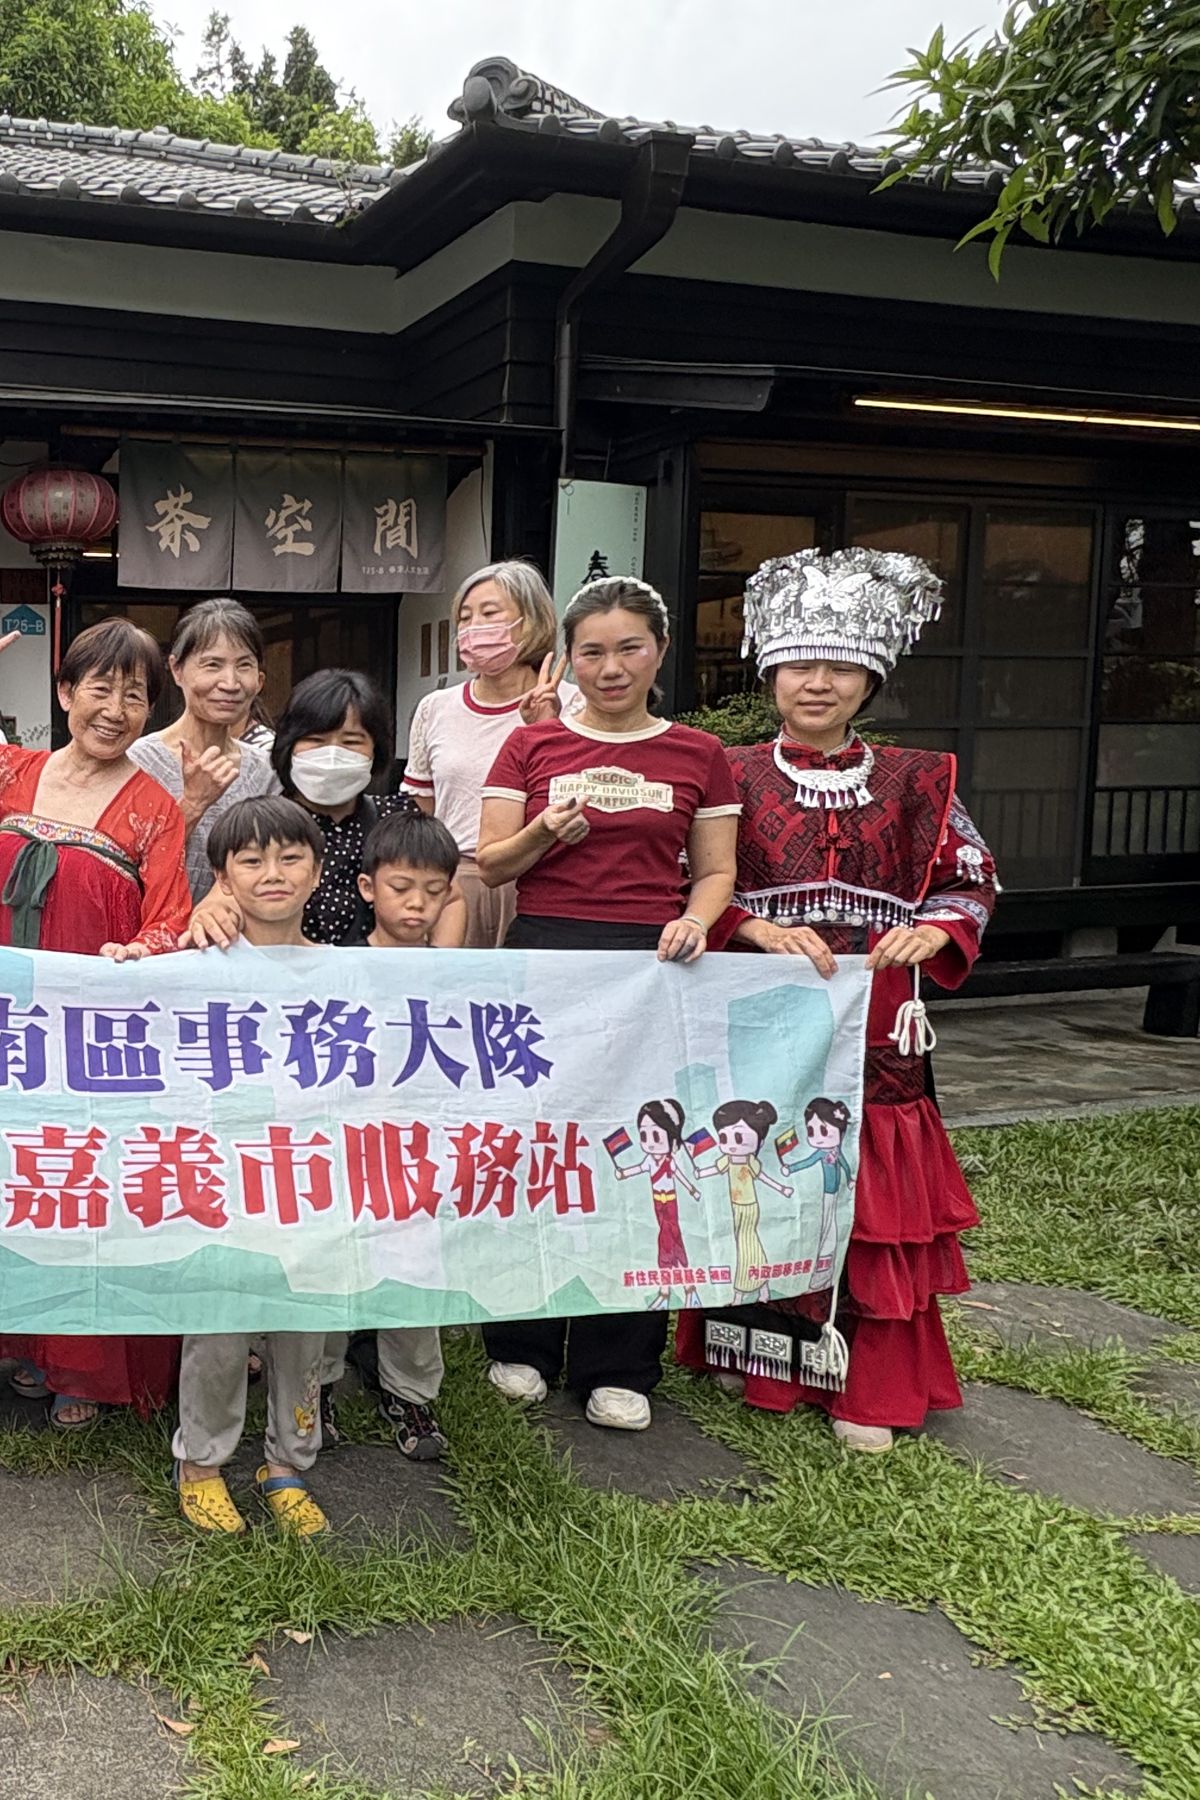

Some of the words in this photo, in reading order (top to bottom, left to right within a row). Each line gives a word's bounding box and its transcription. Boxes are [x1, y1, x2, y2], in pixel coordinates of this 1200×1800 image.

[146, 483, 418, 560] 茶空間
[3, 1123, 597, 1231] 嘉義市服務站
